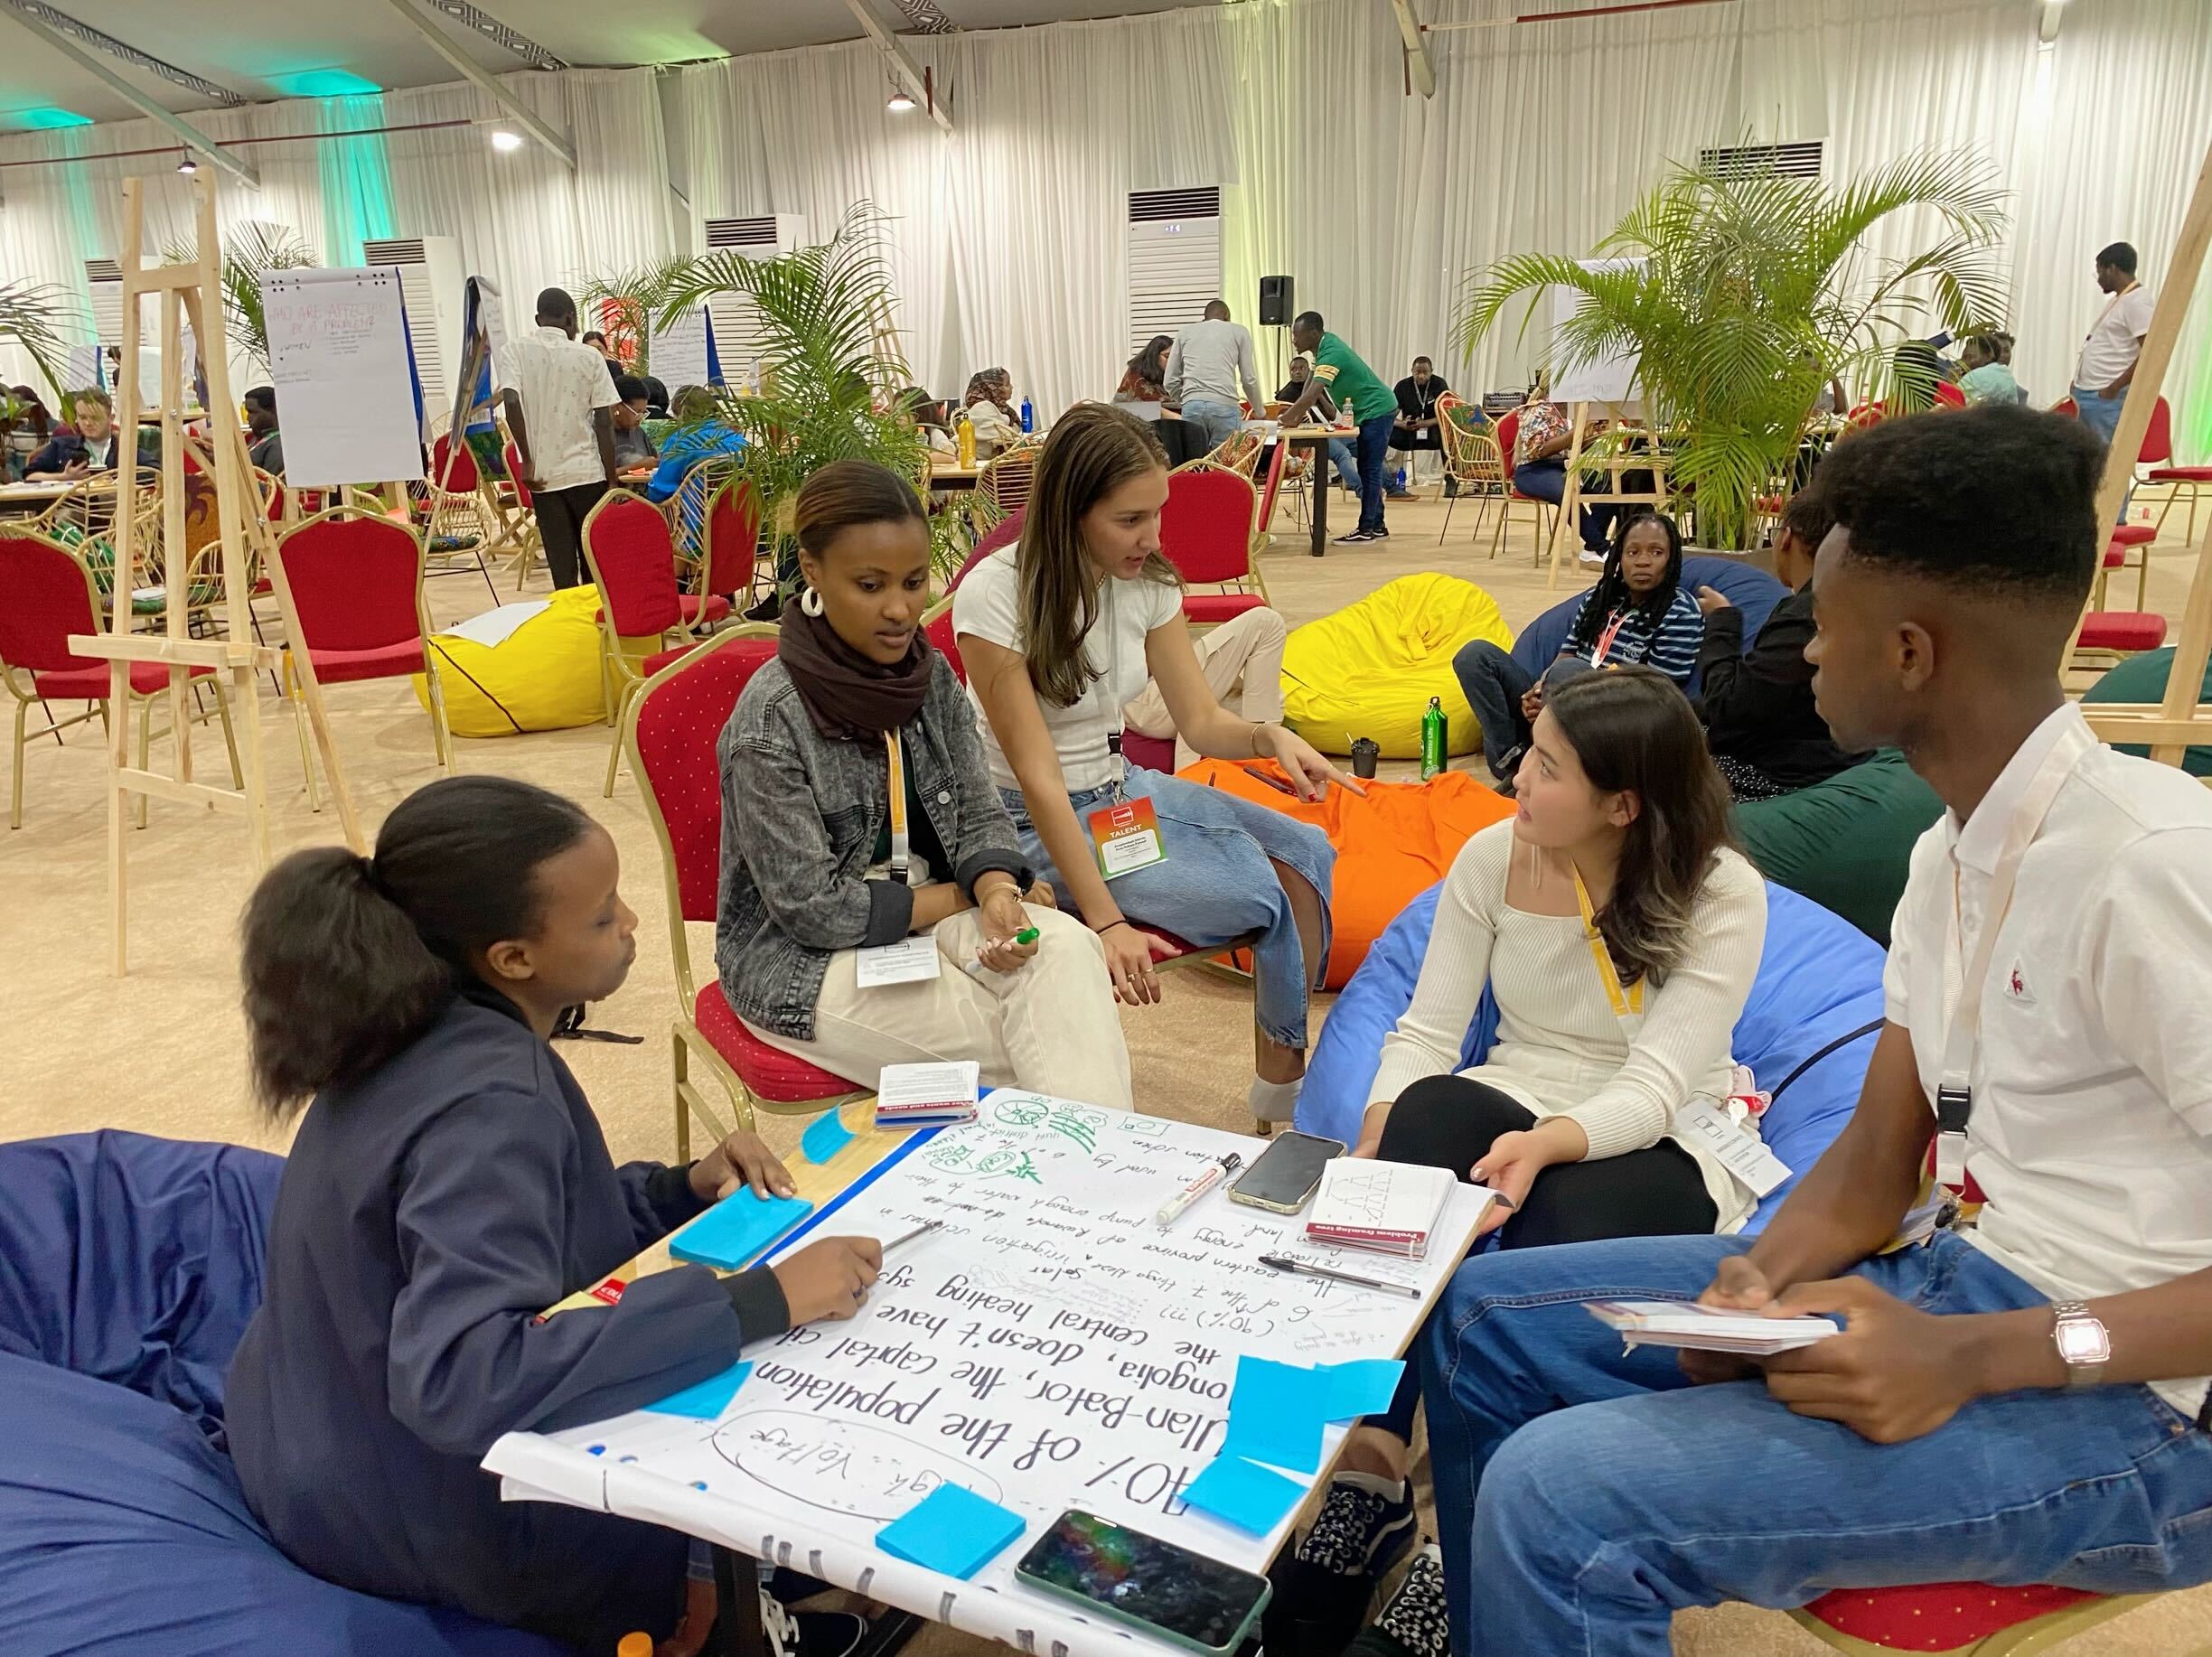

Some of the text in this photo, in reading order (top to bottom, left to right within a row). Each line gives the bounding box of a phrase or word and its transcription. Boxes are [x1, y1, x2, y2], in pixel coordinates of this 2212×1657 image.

[1110, 824, 1142, 838] TALENT
[947, 1182, 965, 1195] to
[1034, 1195, 1090, 1219] enough
[1098, 1211, 1148, 1229] pump
[1336, 1226, 1375, 1235] framing
[1157, 1226, 1174, 1239] to
[1190, 1228, 1243, 1250] energy
[1376, 1230, 1418, 1239] Problem
[1142, 1243, 1208, 1263] province
[1213, 1258, 1279, 1279] eastern
[935, 1274, 1034, 1323] heating
[1221, 1288, 1247, 1307] the
[1307, 1278, 1337, 1298] the
[774, 1325, 821, 1346] cit
[1049, 1310, 1149, 1347] central
[875, 1305, 1232, 1409] ongolia, doesn't have
[1174, 1341, 1222, 1364] the
[950, 1361, 1006, 1400] the
[755, 1362, 942, 1425] population
[940, 1414, 1013, 1460] the
[1013, 1428, 1082, 1471] of
